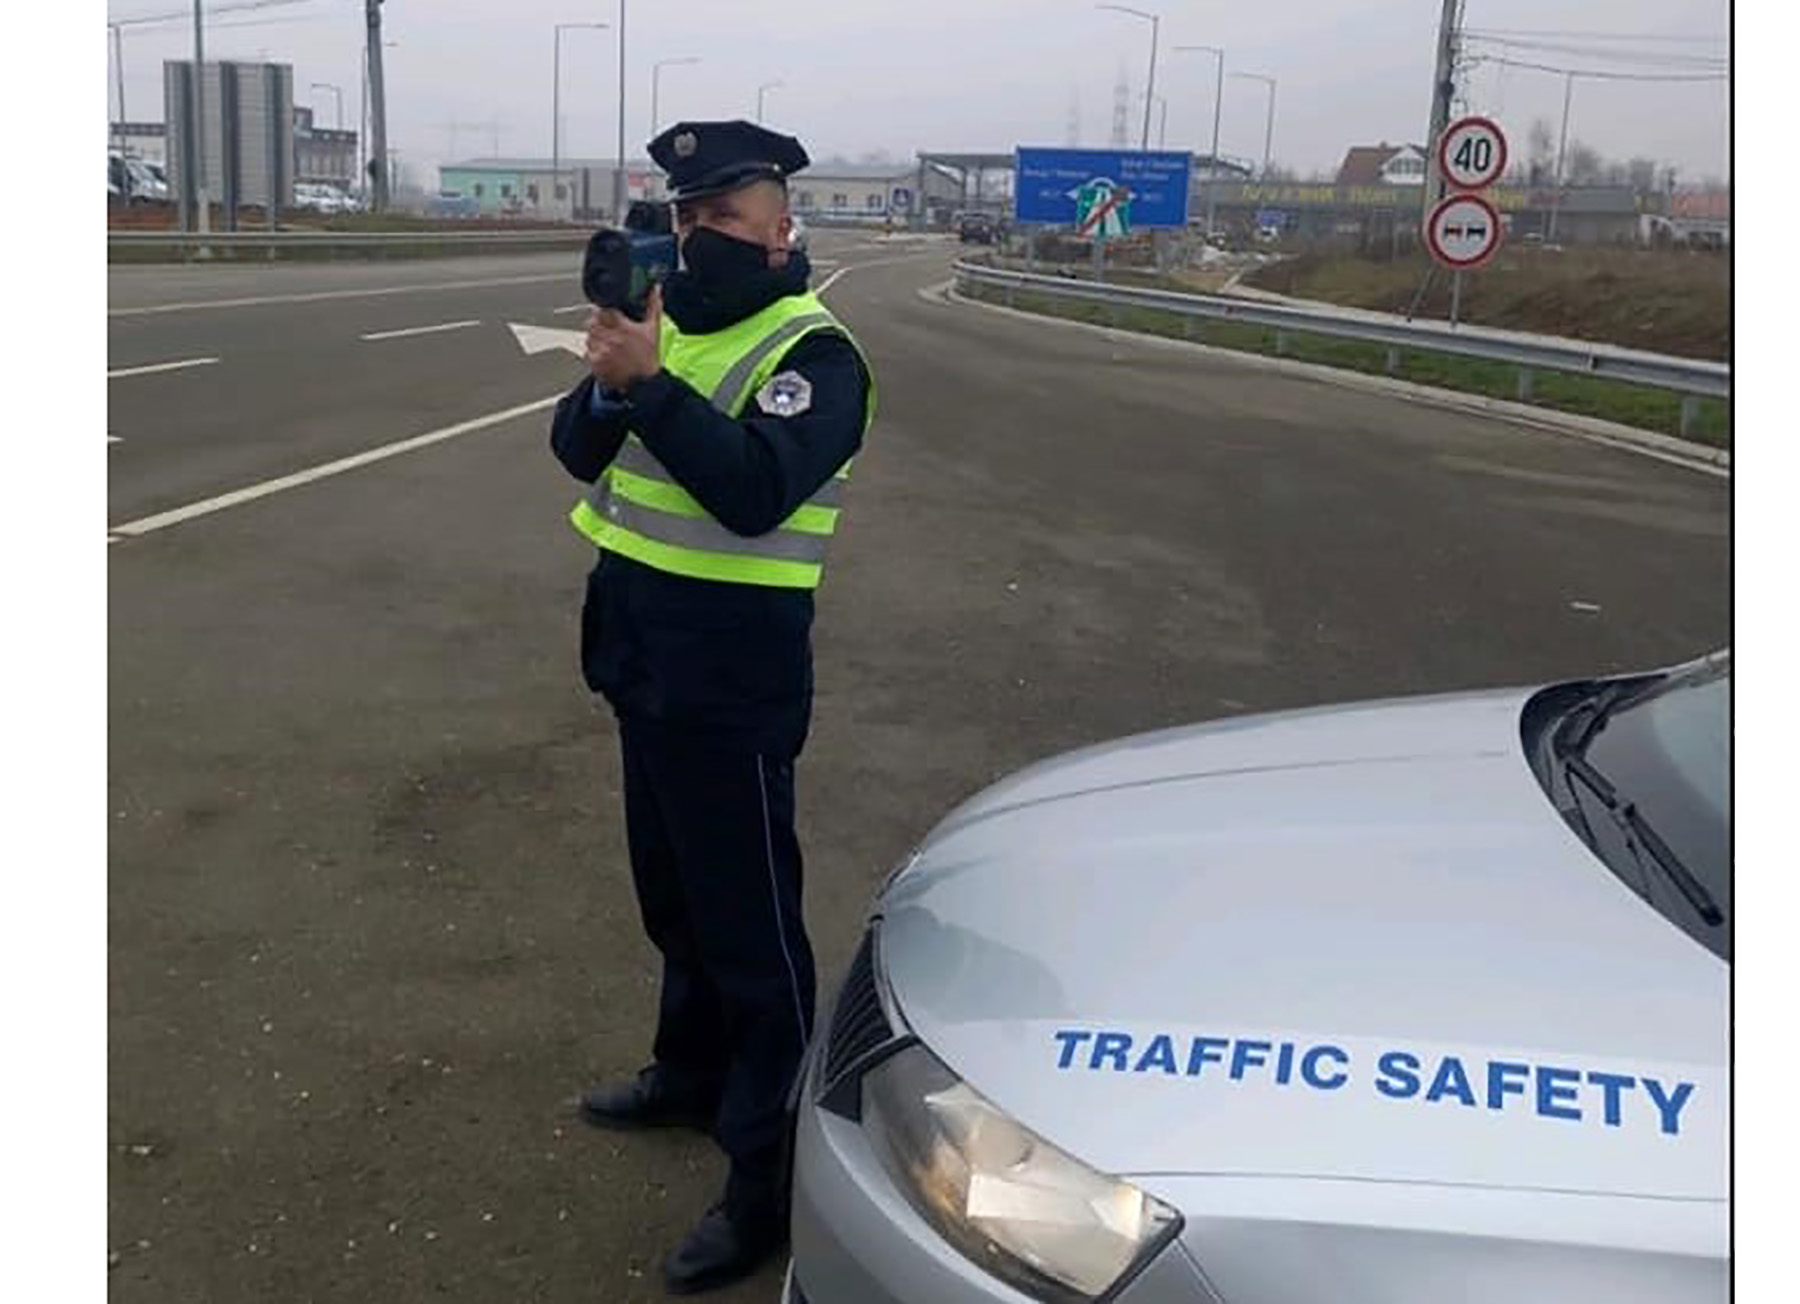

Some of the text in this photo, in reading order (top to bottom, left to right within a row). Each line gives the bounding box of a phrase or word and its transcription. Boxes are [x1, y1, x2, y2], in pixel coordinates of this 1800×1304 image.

[1454, 137, 1492, 172] 40
[1054, 1031, 1695, 1135] TRAFFIC SAFETY
